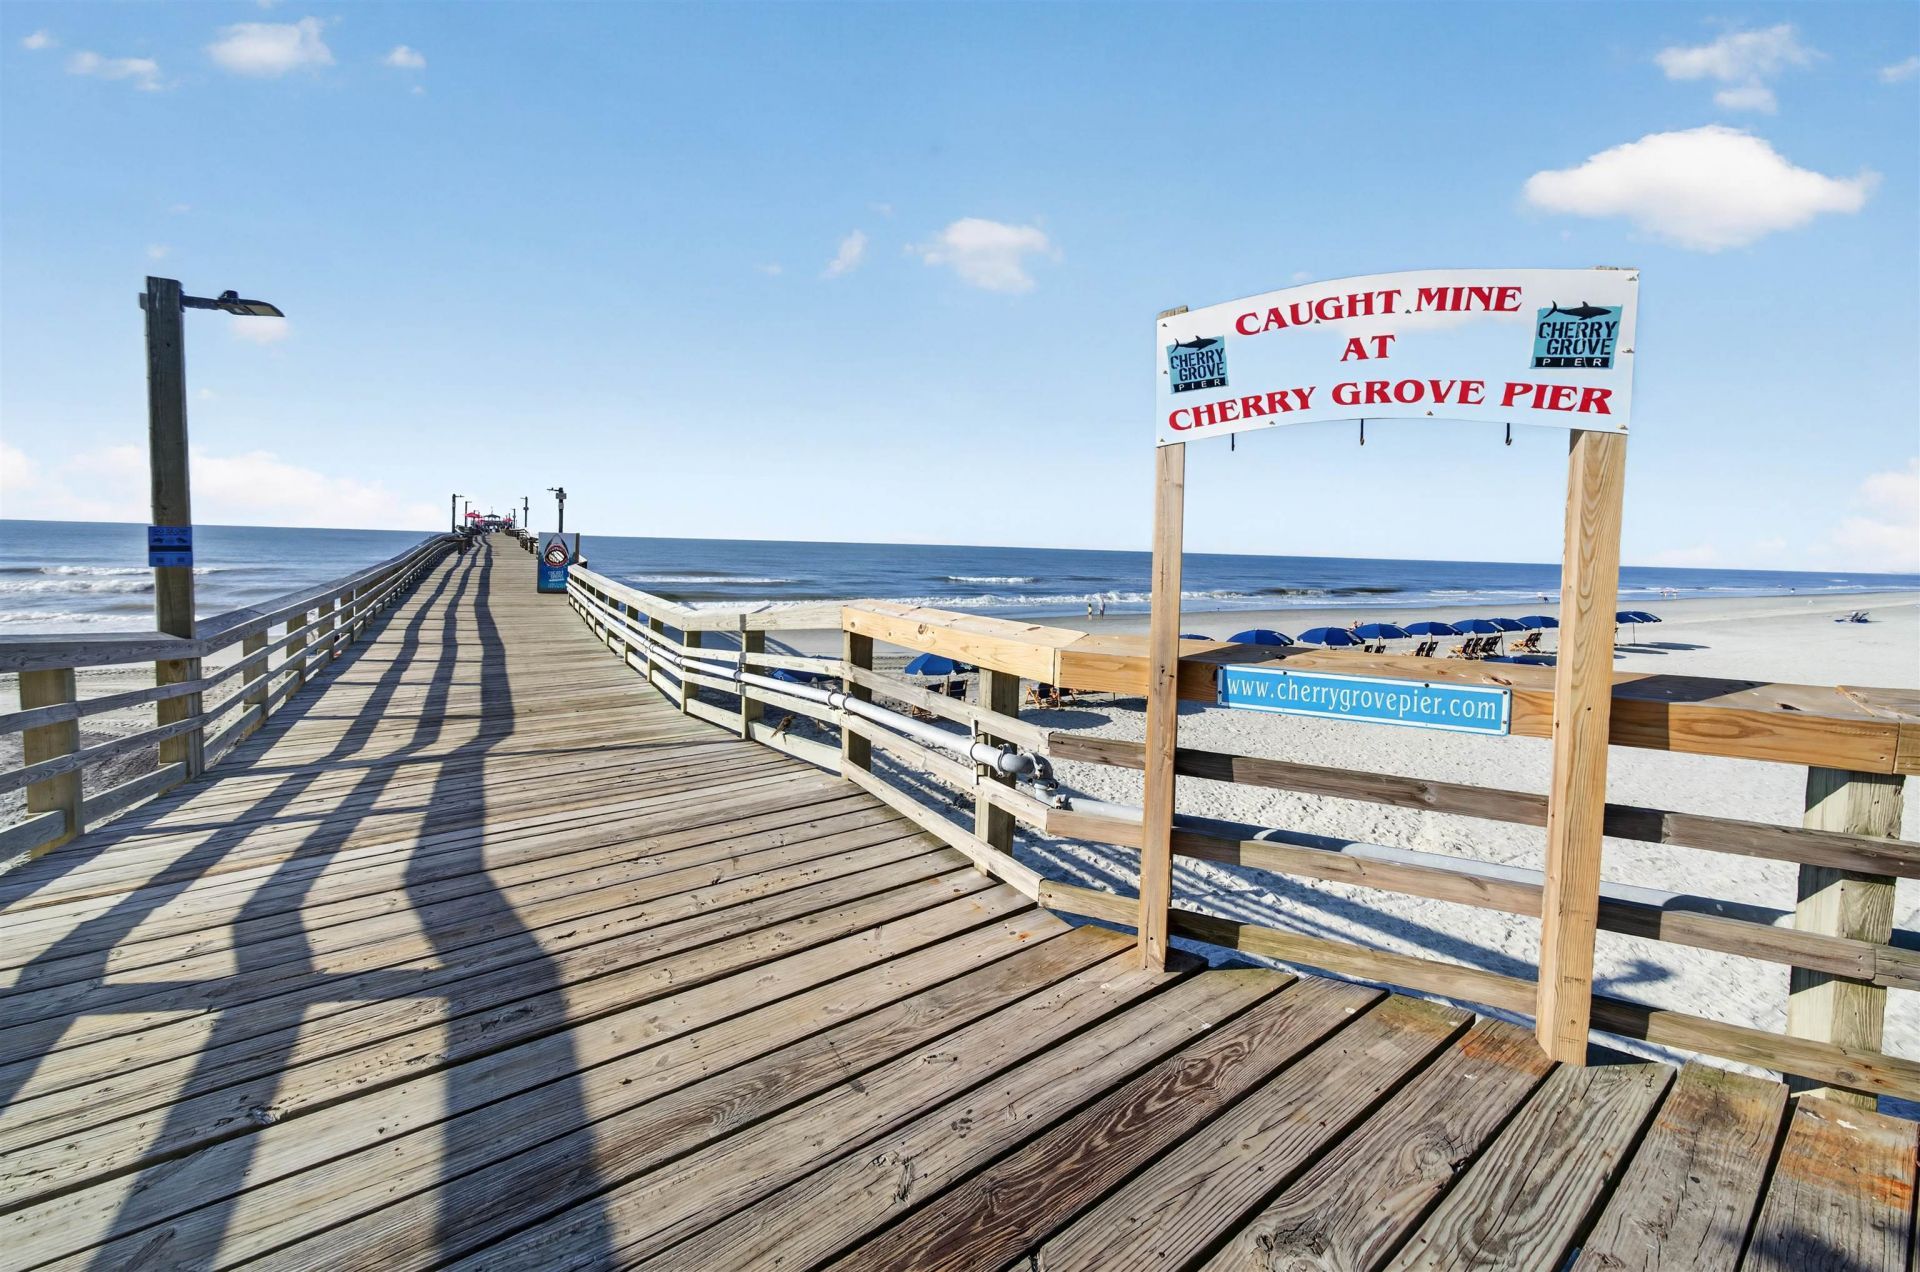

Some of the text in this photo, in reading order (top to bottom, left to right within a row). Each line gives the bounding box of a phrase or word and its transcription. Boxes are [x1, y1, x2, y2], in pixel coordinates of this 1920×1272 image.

[1235, 286, 1522, 336] CAUGHT MINE
[1539, 321, 1618, 339] CHERRY
[1341, 334, 1396, 361] AT
[1546, 338, 1614, 355] GROVE
[1170, 348, 1224, 369] CHERRY
[1542, 357, 1602, 367] PIER
[1179, 362, 1225, 382] GROVE
[1178, 379, 1221, 391] PIER
[1169, 379, 1613, 431] CHERRY GROVE PIER
[1227, 678, 1496, 720] www.cherrygrovepier.com
